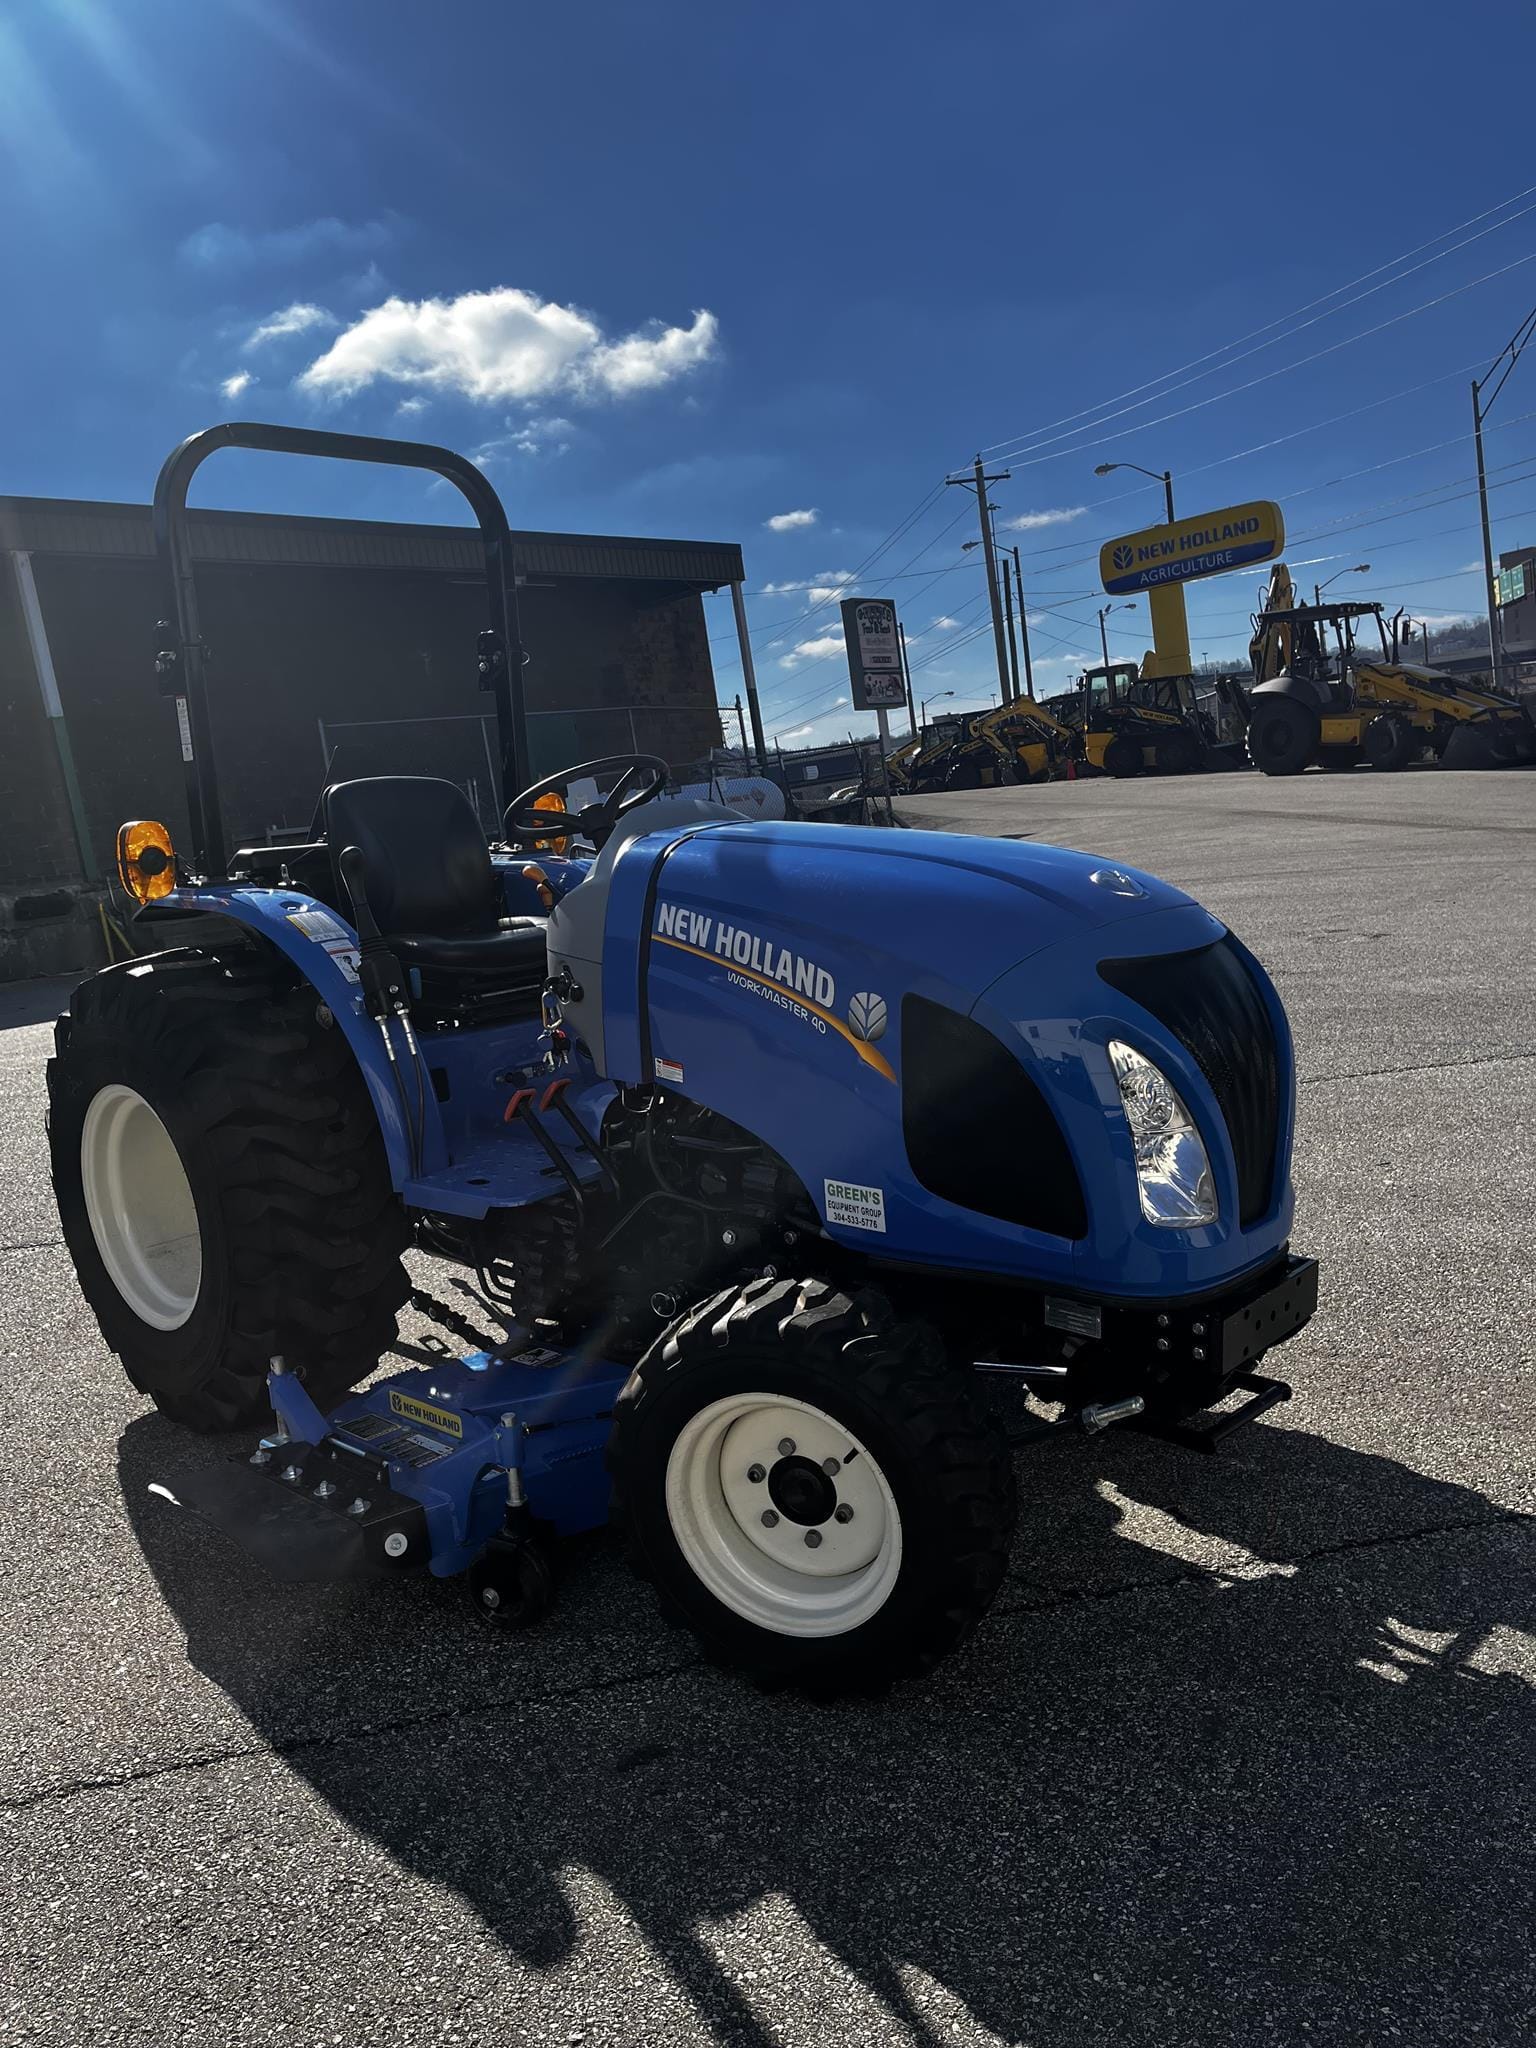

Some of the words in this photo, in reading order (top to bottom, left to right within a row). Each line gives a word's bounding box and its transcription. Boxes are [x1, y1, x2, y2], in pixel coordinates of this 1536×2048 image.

[1137, 538, 1175, 562] NEW
[1180, 516, 1260, 550] HOLLAND
[1140, 551, 1233, 585] AGRICULTURE
[657, 902, 712, 948] NEW
[714, 922, 835, 1009] HOLLAND
[727, 971, 809, 1022] WORKMASTER
[811, 1015, 827, 1034] 40
[827, 1183, 881, 1205] GREEN'S
[827, 1200, 859, 1214] EQUIPMENT
[861, 1207, 882, 1218] GROUP
[403, 1402, 421, 1418] NEW
[423, 1409, 460, 1433] HOLLAND
